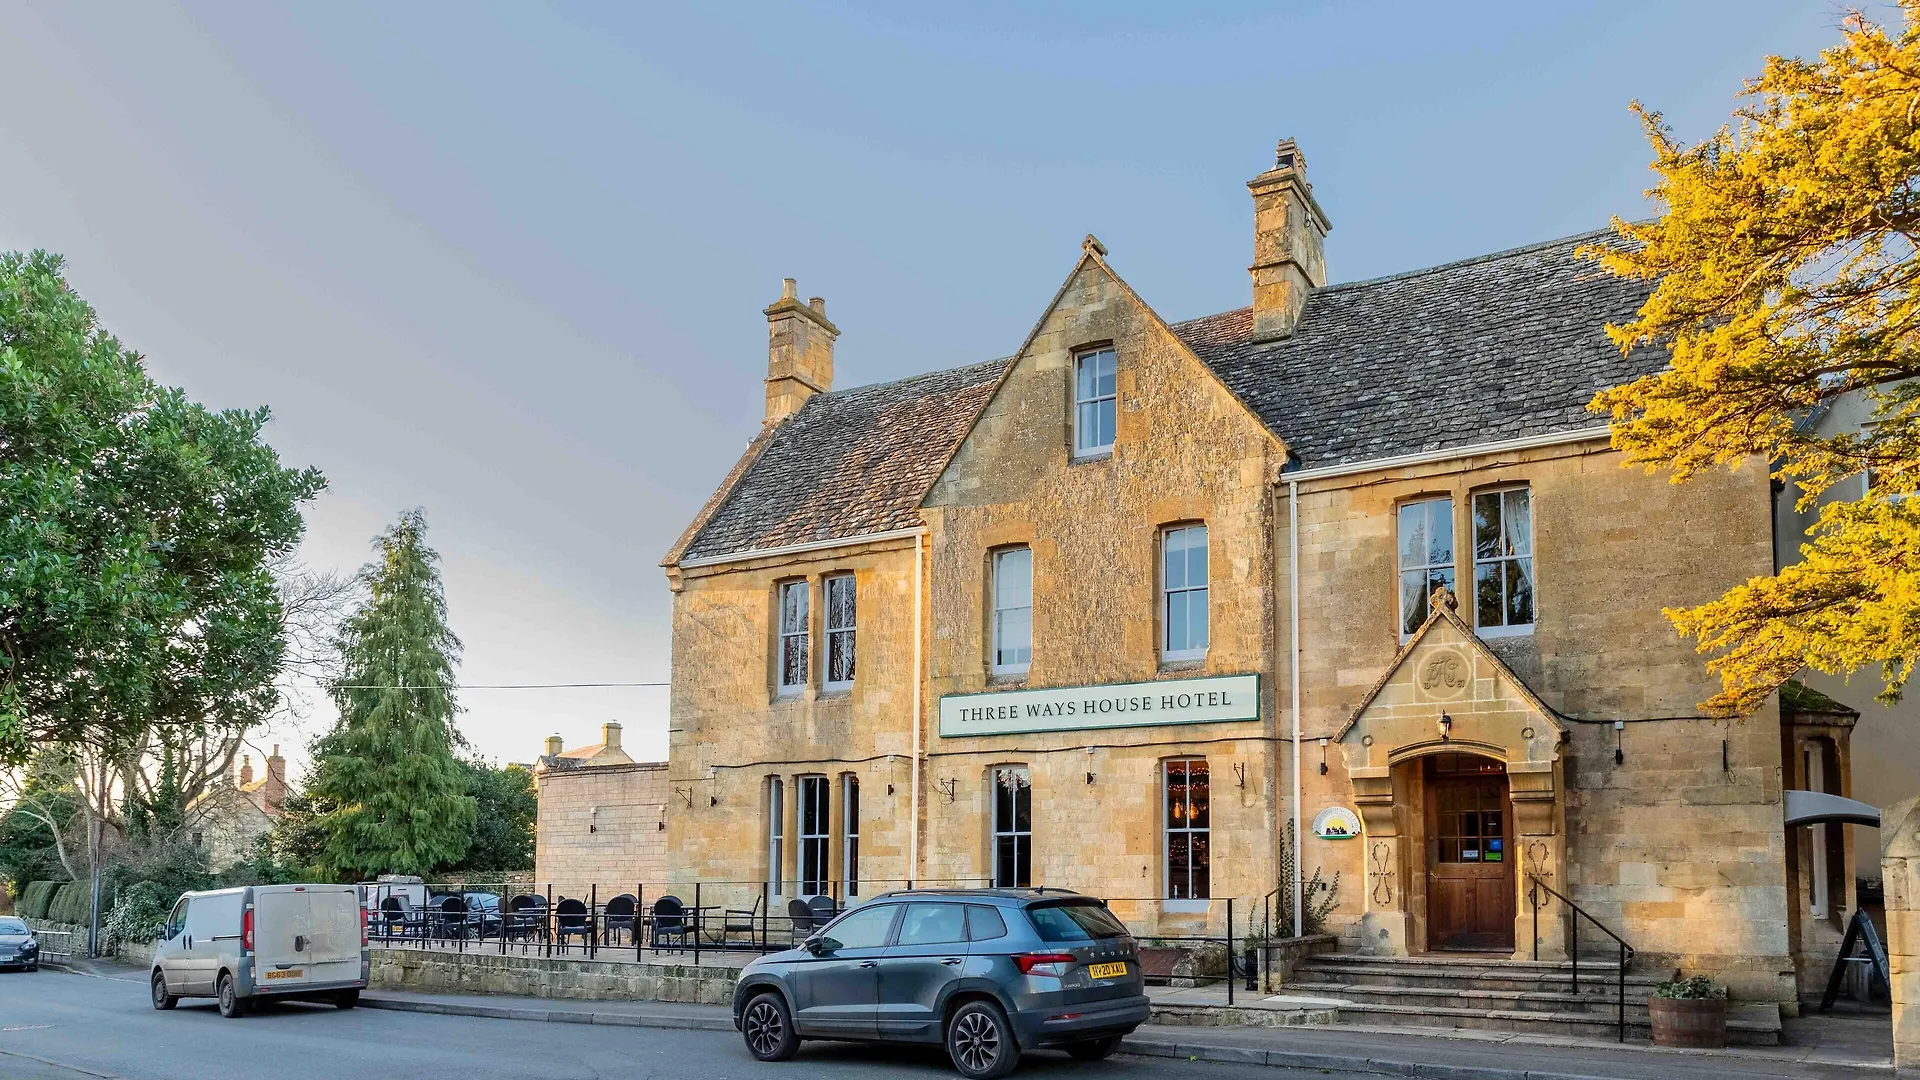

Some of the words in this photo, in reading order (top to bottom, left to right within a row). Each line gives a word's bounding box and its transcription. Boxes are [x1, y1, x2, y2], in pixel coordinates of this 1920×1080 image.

[959, 705, 1018, 722] THREE
[1026, 701, 1076, 718] WAYS
[1083, 696, 1152, 714] HOUSE
[1160, 691, 1232, 710] HOTEL
[267, 971, 286, 979] BG63
